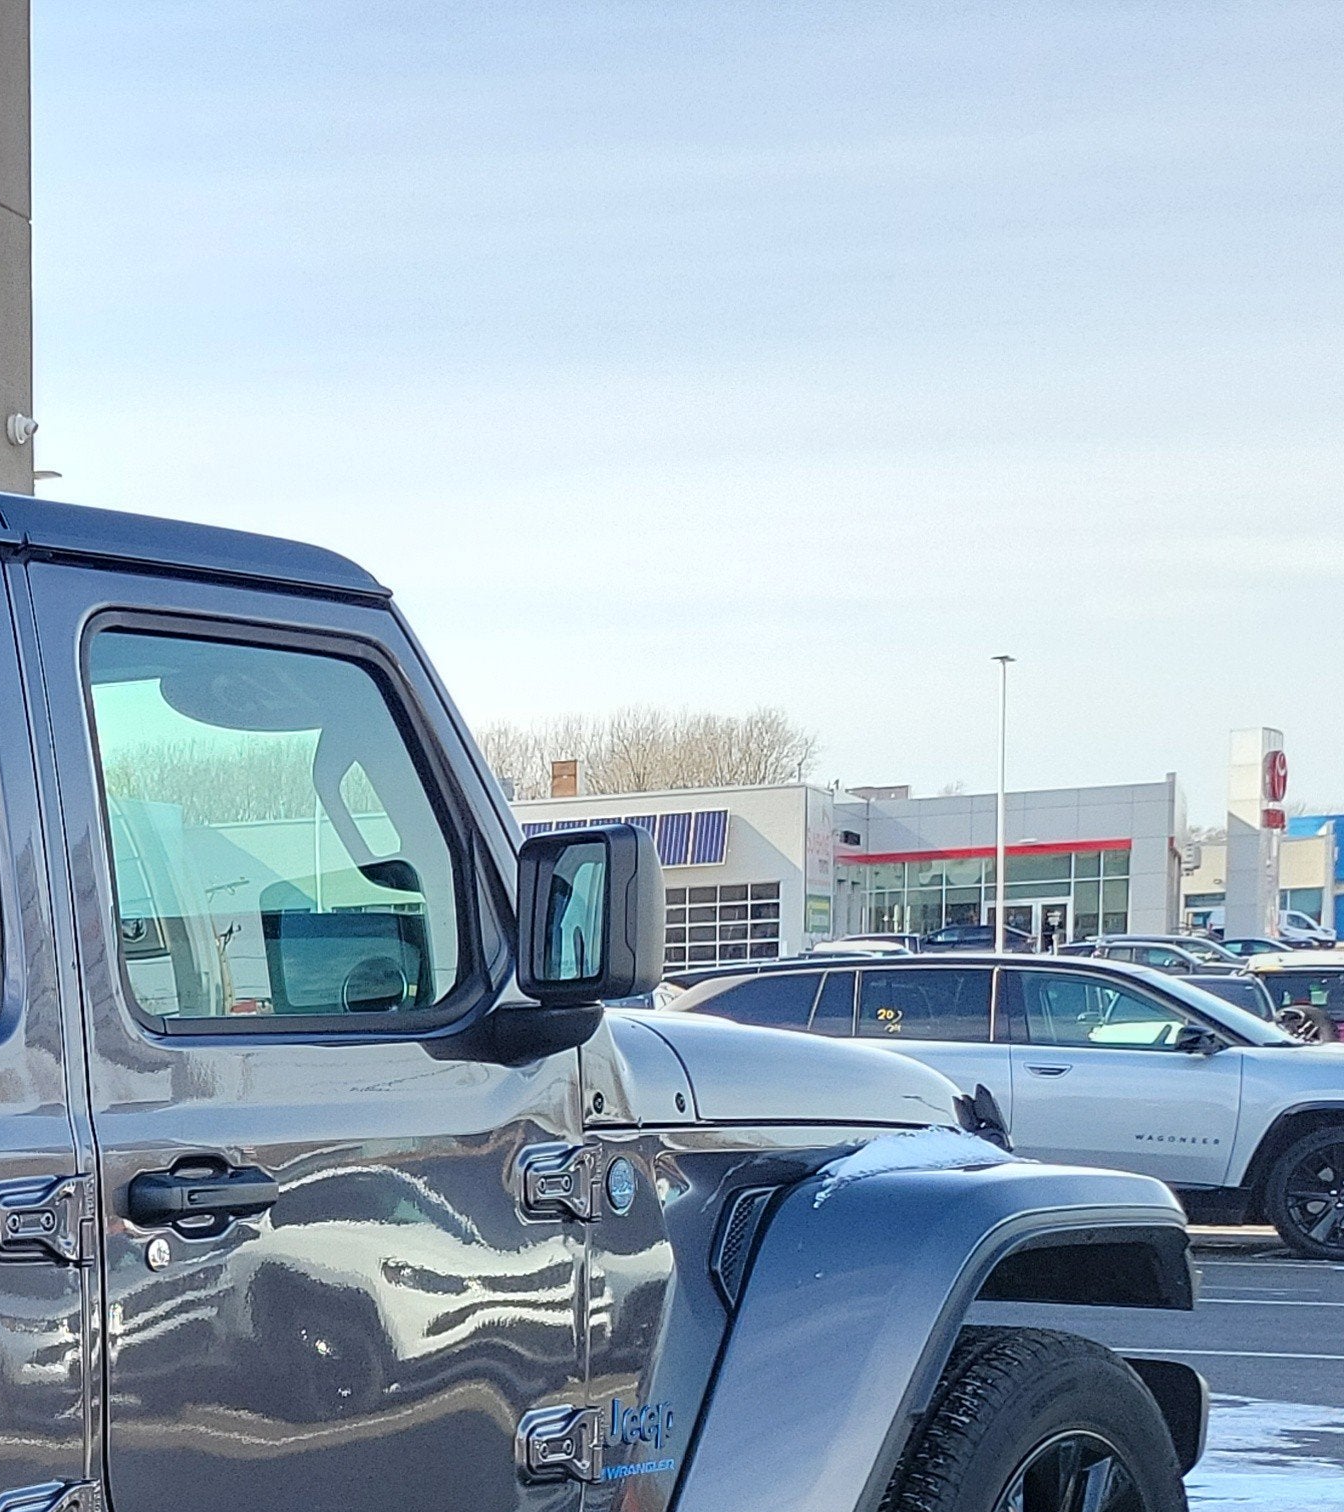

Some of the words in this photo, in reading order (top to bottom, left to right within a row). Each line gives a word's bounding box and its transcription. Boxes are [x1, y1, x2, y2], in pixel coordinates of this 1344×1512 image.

[1134, 1134, 1221, 1146] WAGONEER
[603, 1396, 675, 1450] Jeep
[602, 1458, 675, 1480] WRANGLER
